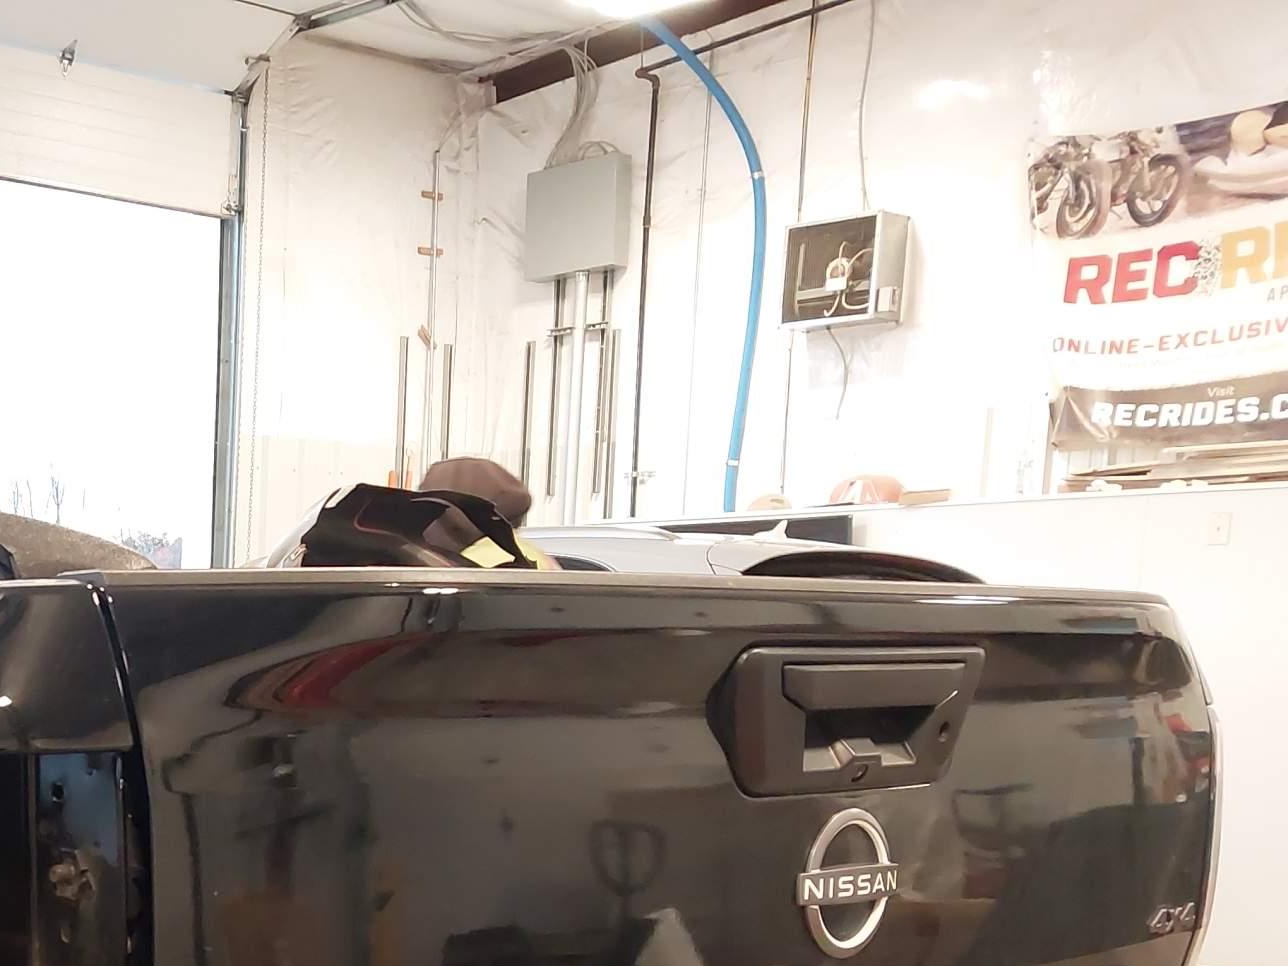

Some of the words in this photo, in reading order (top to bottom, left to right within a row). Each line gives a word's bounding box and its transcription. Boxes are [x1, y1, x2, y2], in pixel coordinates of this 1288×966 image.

[1063, 240, 1200, 305] REC
[1207, 386, 1235, 398] Visit
[804, 869, 898, 901] NISSAN
